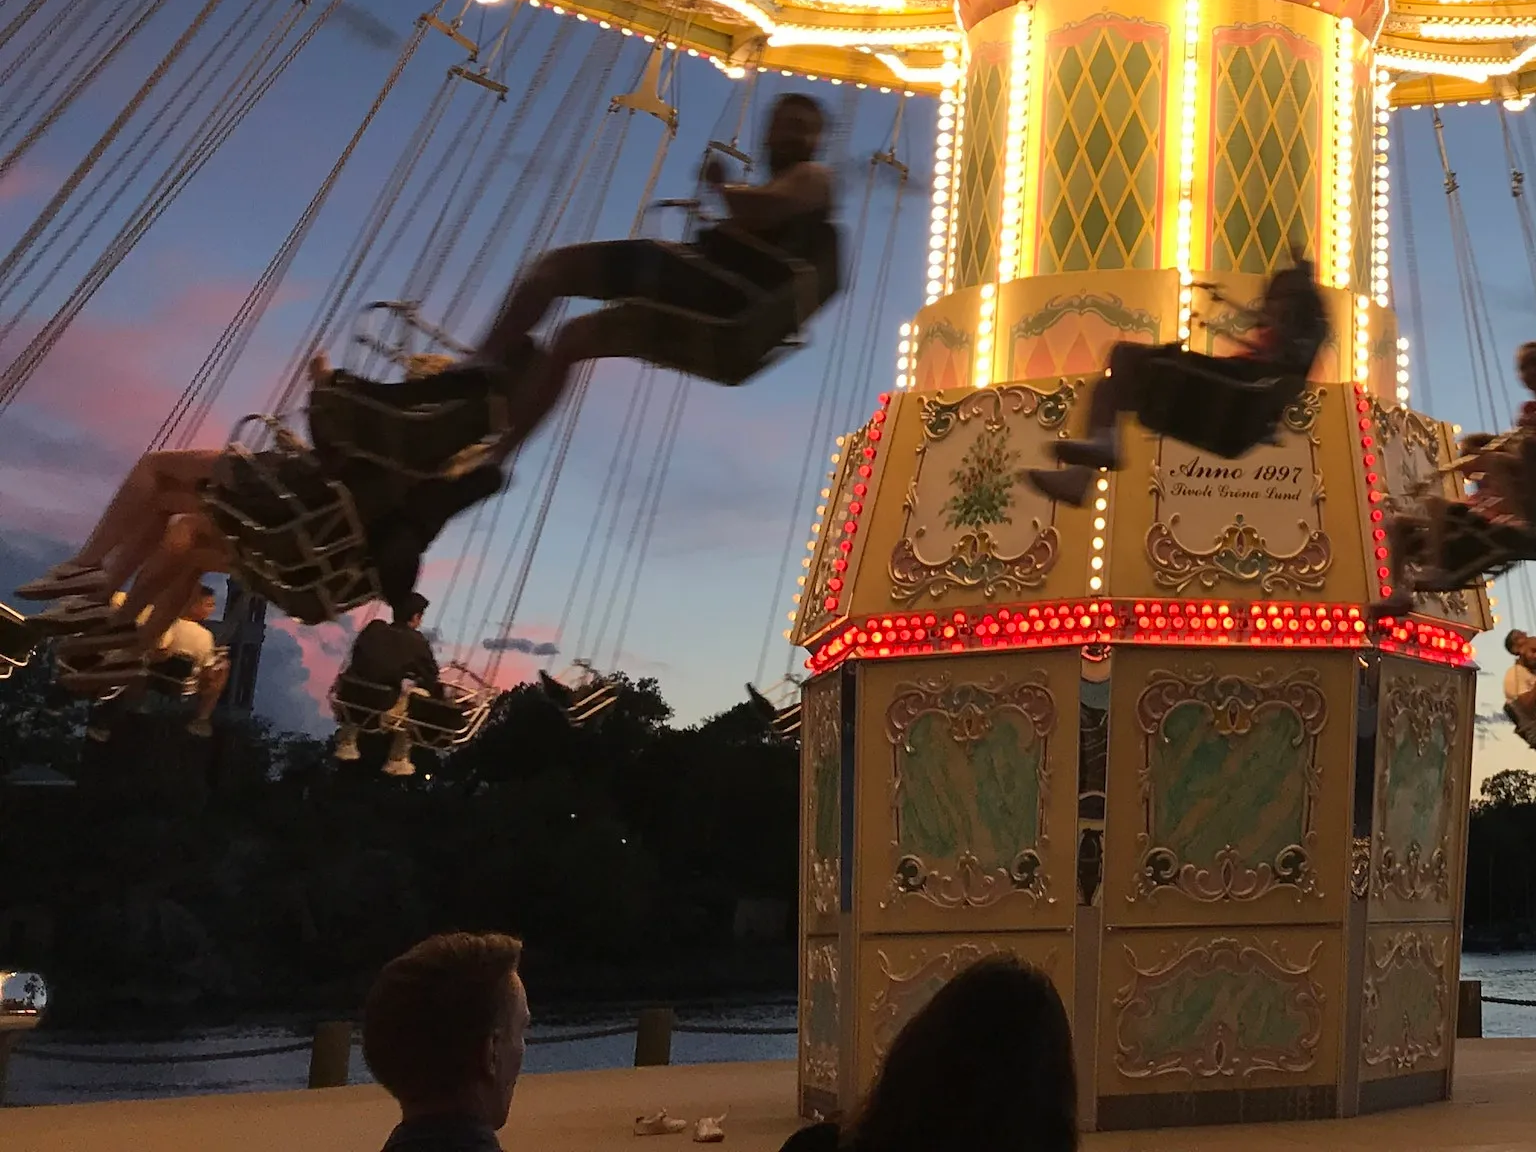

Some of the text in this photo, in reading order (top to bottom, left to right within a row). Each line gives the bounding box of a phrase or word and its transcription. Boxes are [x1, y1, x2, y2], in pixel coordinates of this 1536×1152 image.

[1169, 456, 1243, 480] Anno
[1170, 482, 1302, 501] Tivoli Gröna Lund
